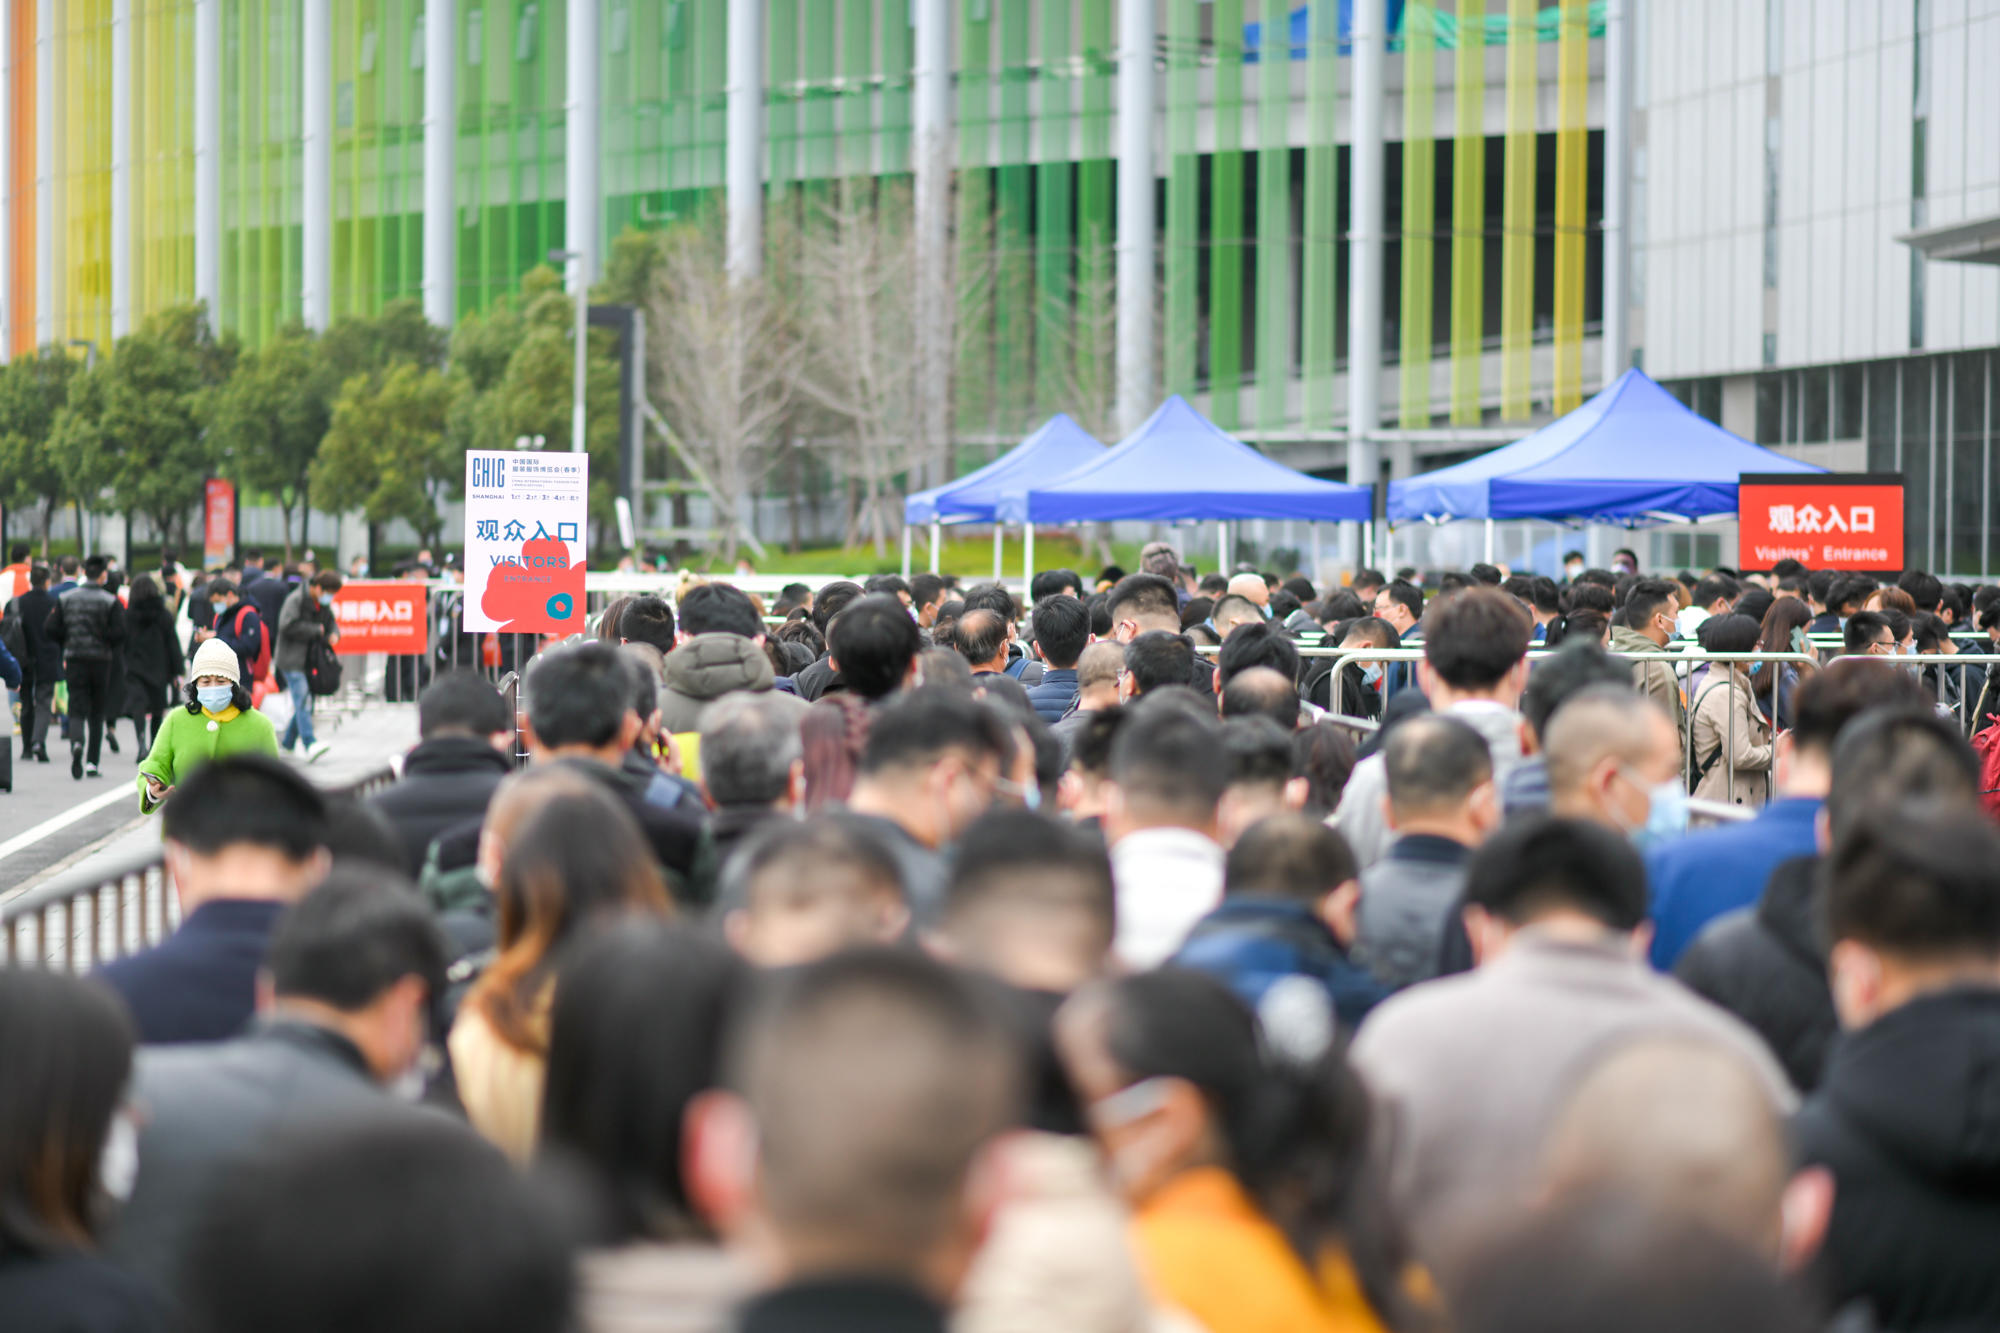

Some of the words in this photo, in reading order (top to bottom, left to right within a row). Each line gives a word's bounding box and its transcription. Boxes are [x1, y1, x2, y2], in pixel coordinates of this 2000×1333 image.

[472, 457, 505, 488] CHIC
[1768, 504, 1875, 533] 观众入口
[476, 519, 578, 542] 观众入口
[490, 555, 568, 568] VISITORS
[1823, 546, 1888, 562] Entrance
[504, 575, 552, 583] ENTRANCE
